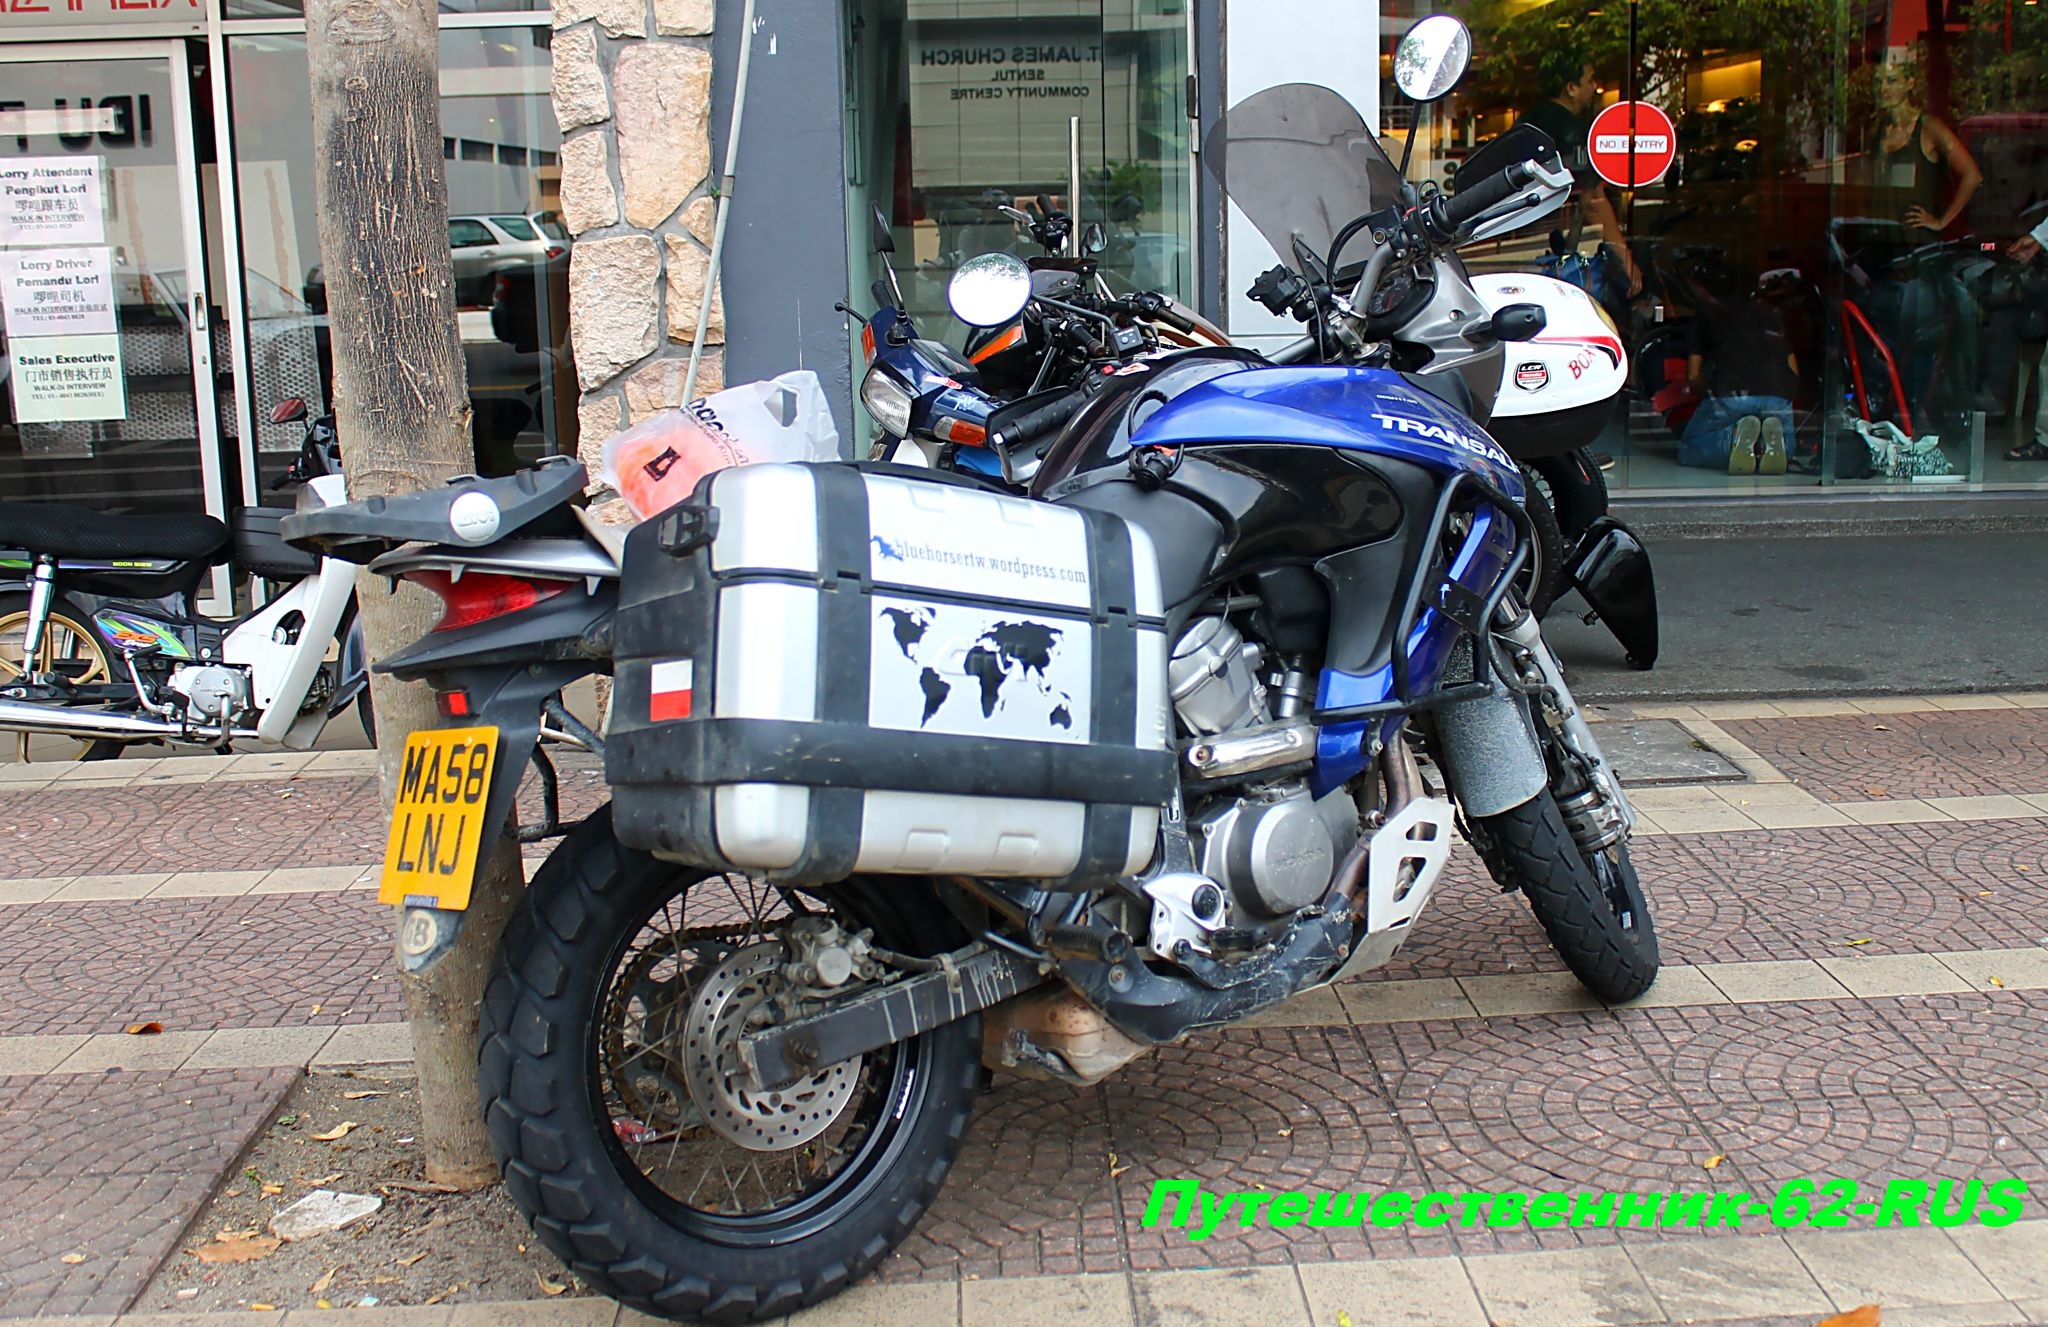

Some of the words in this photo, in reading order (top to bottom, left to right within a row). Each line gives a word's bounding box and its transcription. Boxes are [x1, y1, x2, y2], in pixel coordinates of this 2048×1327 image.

[1599, 140, 1617, 149] NO
[0, 169, 29, 180] Lorry
[32, 167, 94, 178] Attendant
[5, 184, 60, 196] Pengikut
[62, 183, 87, 193] Lori
[45, 213, 86, 222] INTERVIEW
[20, 260, 52, 271] Lorry
[56, 258, 93, 269] Driver
[16, 276, 73, 287] Pemandu
[76, 274, 99, 285] Lori
[41, 305, 74, 314] INTERVIEW
[19, 355, 52, 365] Sales
[55, 353, 115, 364] Executive
[33, 384, 65, 392] WALK-IN
[66, 382, 107, 391] INTERVIEW
[1371, 413, 1521, 475] TRANSAL
[399, 743, 488, 804] MA58
[396, 813, 466, 876] LNJ
